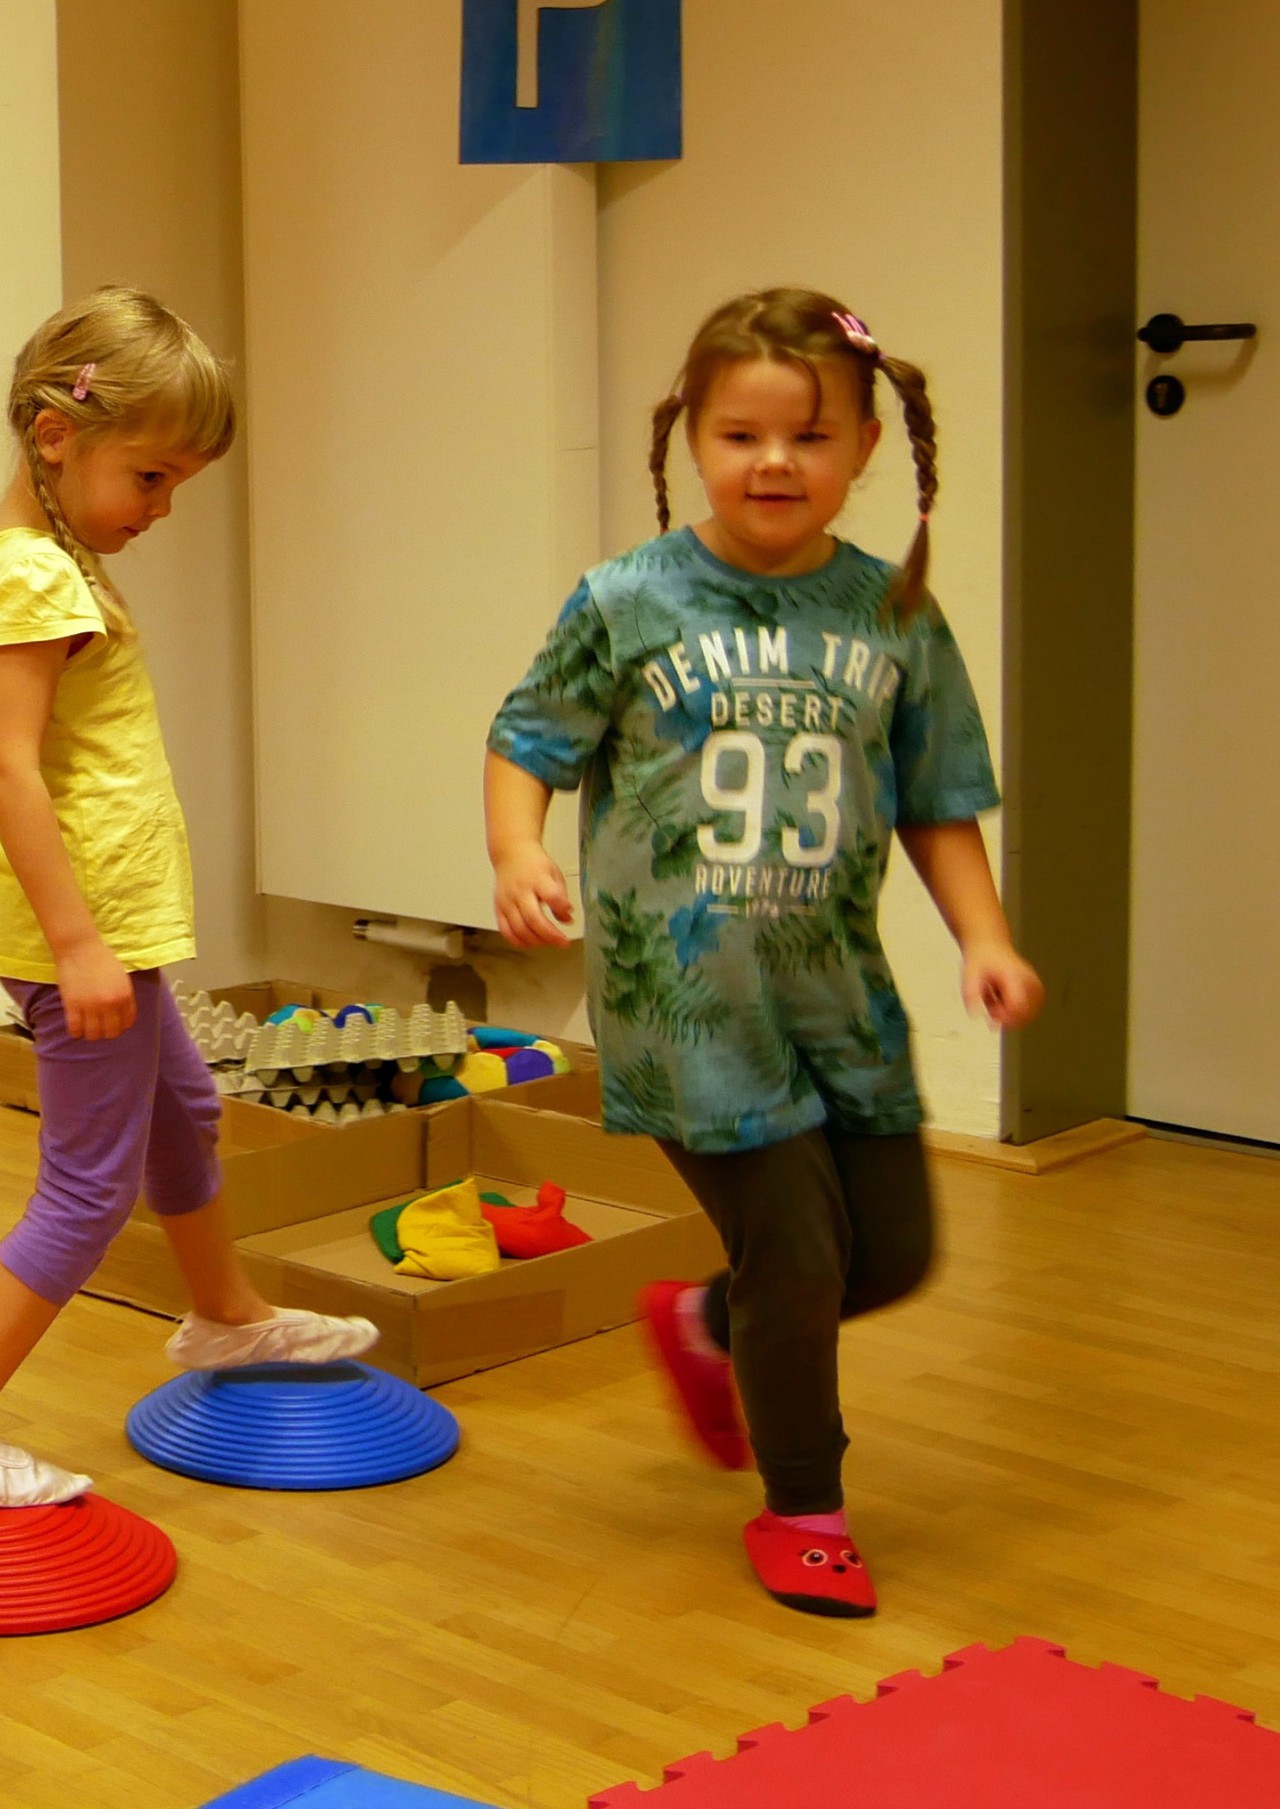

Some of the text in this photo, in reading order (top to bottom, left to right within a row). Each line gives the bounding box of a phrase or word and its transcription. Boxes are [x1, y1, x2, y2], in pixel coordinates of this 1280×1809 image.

[642, 626, 788, 711] DENIM
[711, 691, 844, 730] DESERT
[696, 731, 843, 867] 93
[695, 863, 832, 898] ADVENTURE
